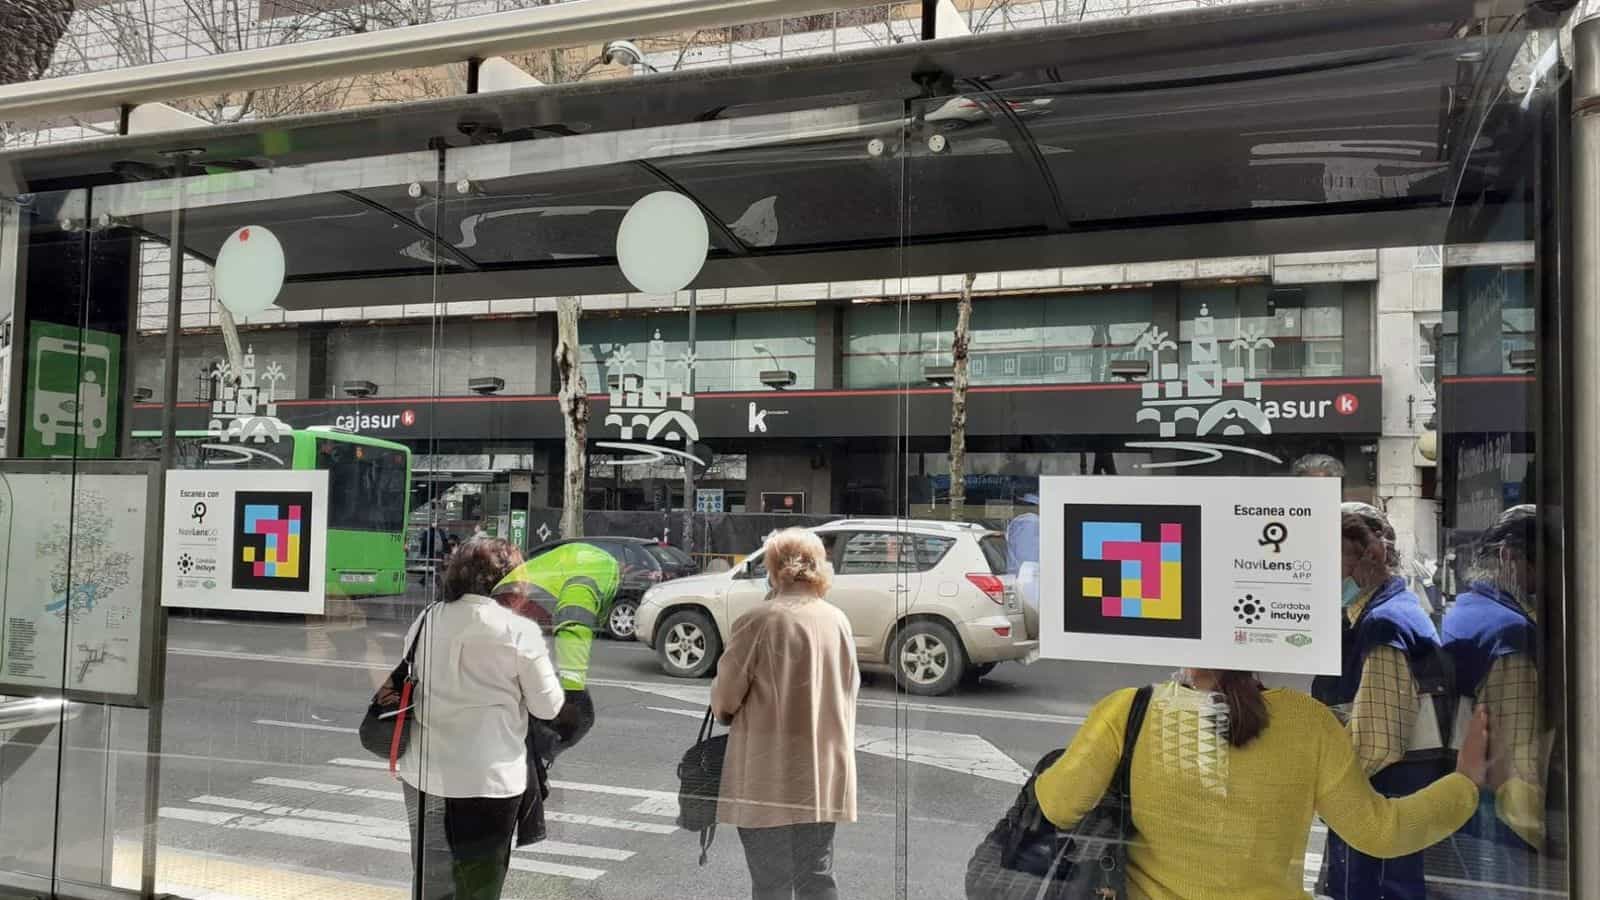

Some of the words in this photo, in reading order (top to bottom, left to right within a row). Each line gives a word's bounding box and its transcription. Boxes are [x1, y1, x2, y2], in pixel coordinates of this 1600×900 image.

[335, 410, 400, 432] cajasur
[748, 401, 767, 432] k
[1233, 504, 1285, 517] Escanea
[1288, 506, 1312, 517] con
[1233, 559, 1312, 571] NaviLensGO
[1270, 611, 1311, 623] incluye
